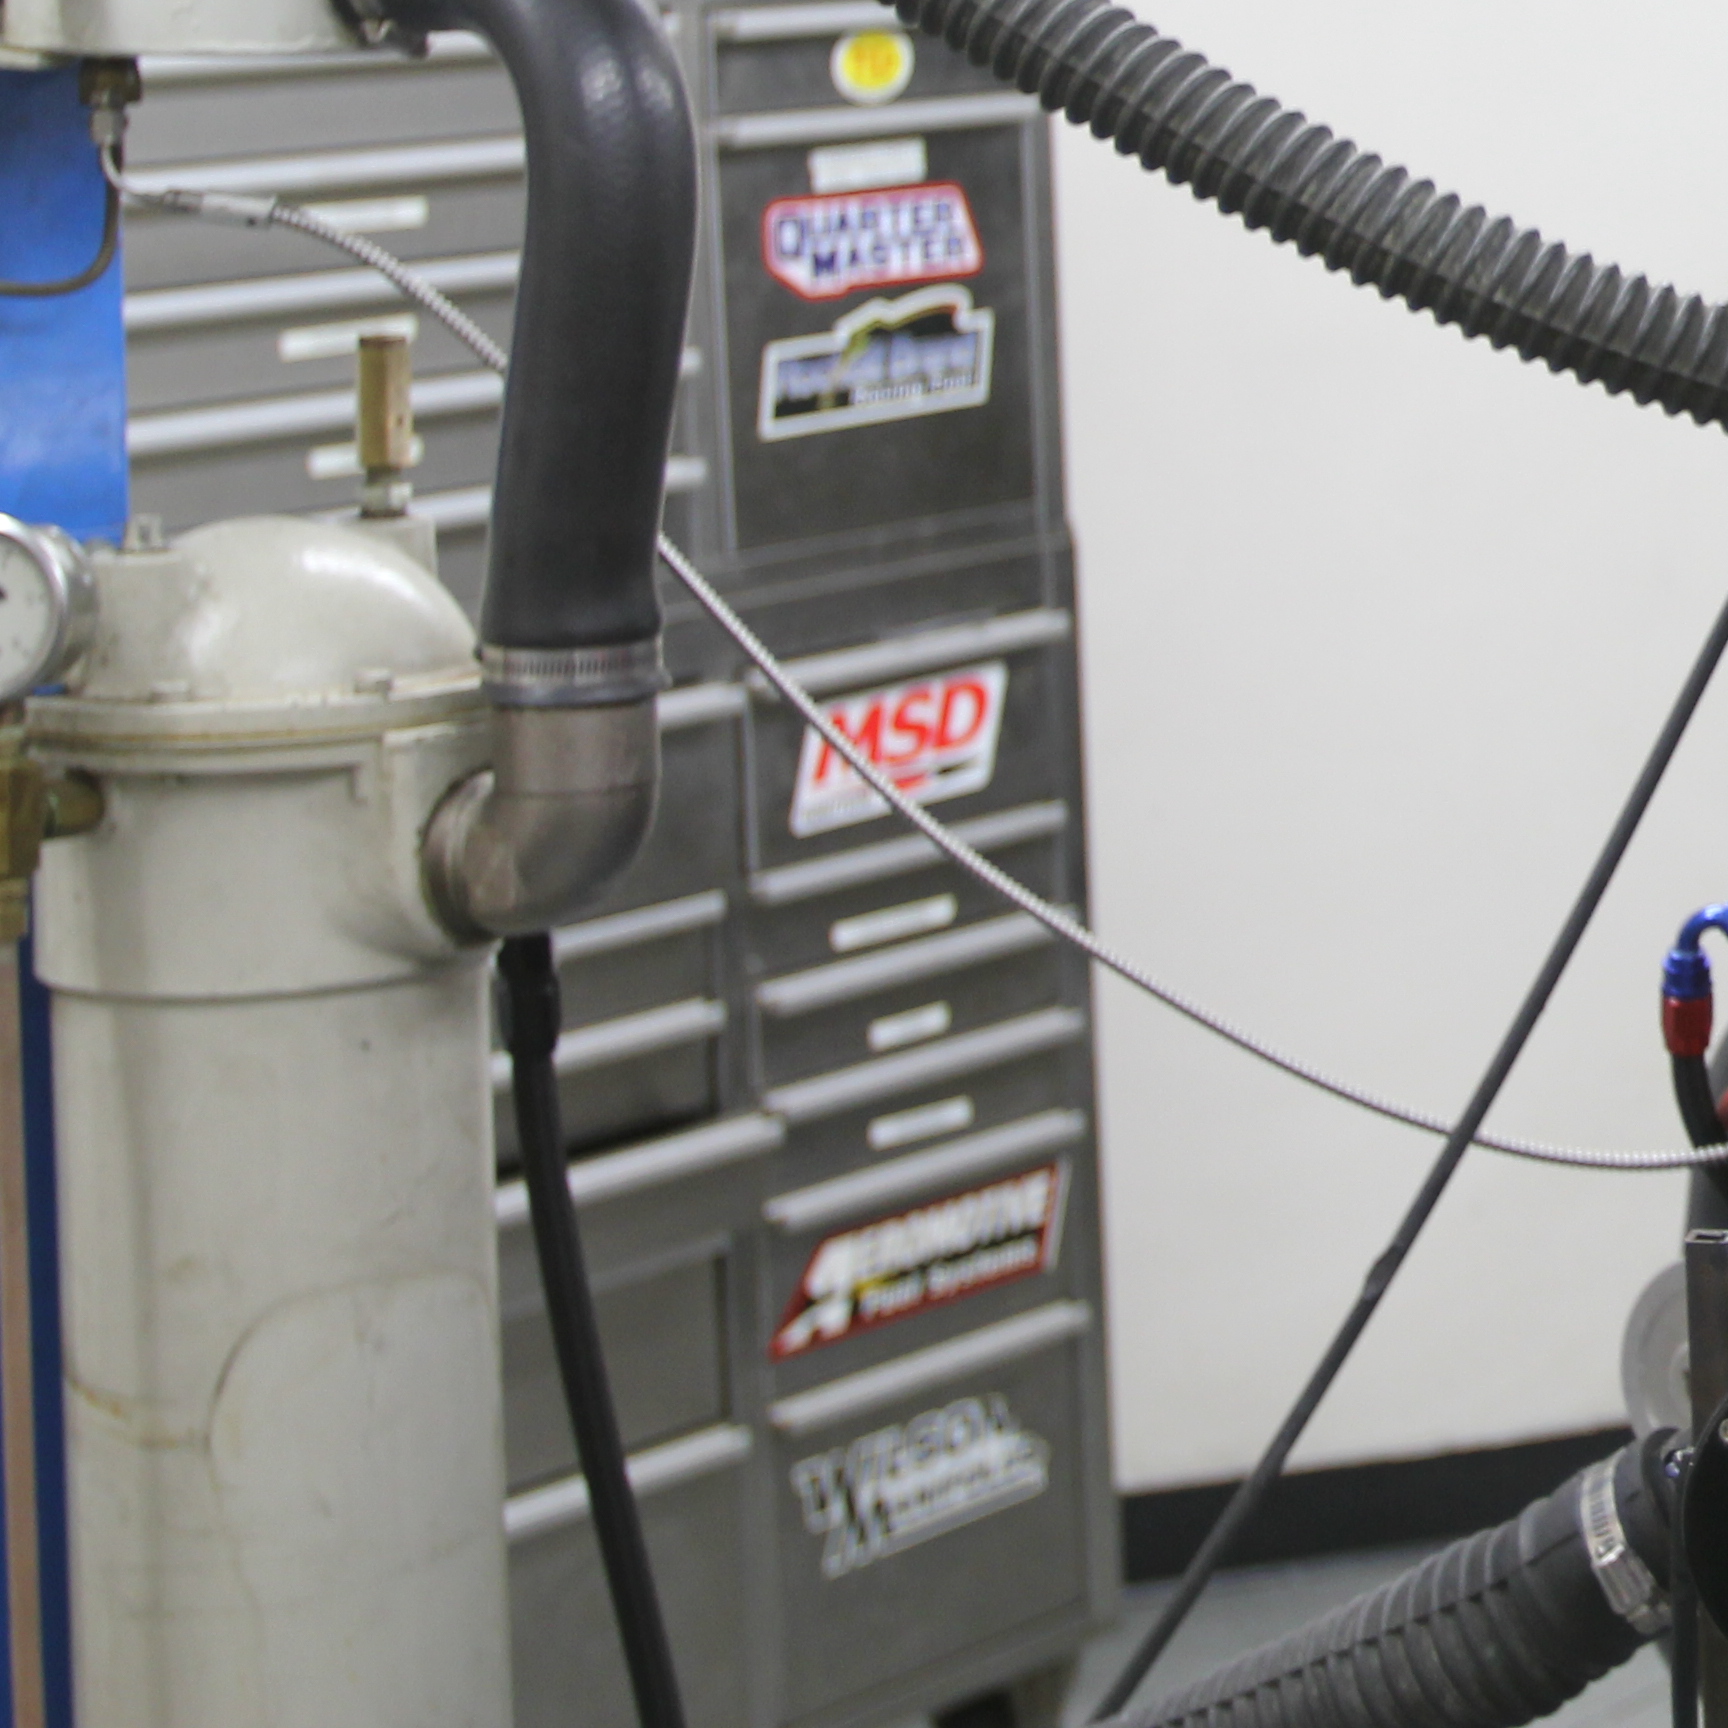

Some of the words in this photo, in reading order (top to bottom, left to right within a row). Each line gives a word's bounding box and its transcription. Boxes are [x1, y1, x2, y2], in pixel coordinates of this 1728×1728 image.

[772, 199, 957, 260] QUARTER
[810, 229, 967, 278] MASTER
[811, 674, 992, 787] MSD
